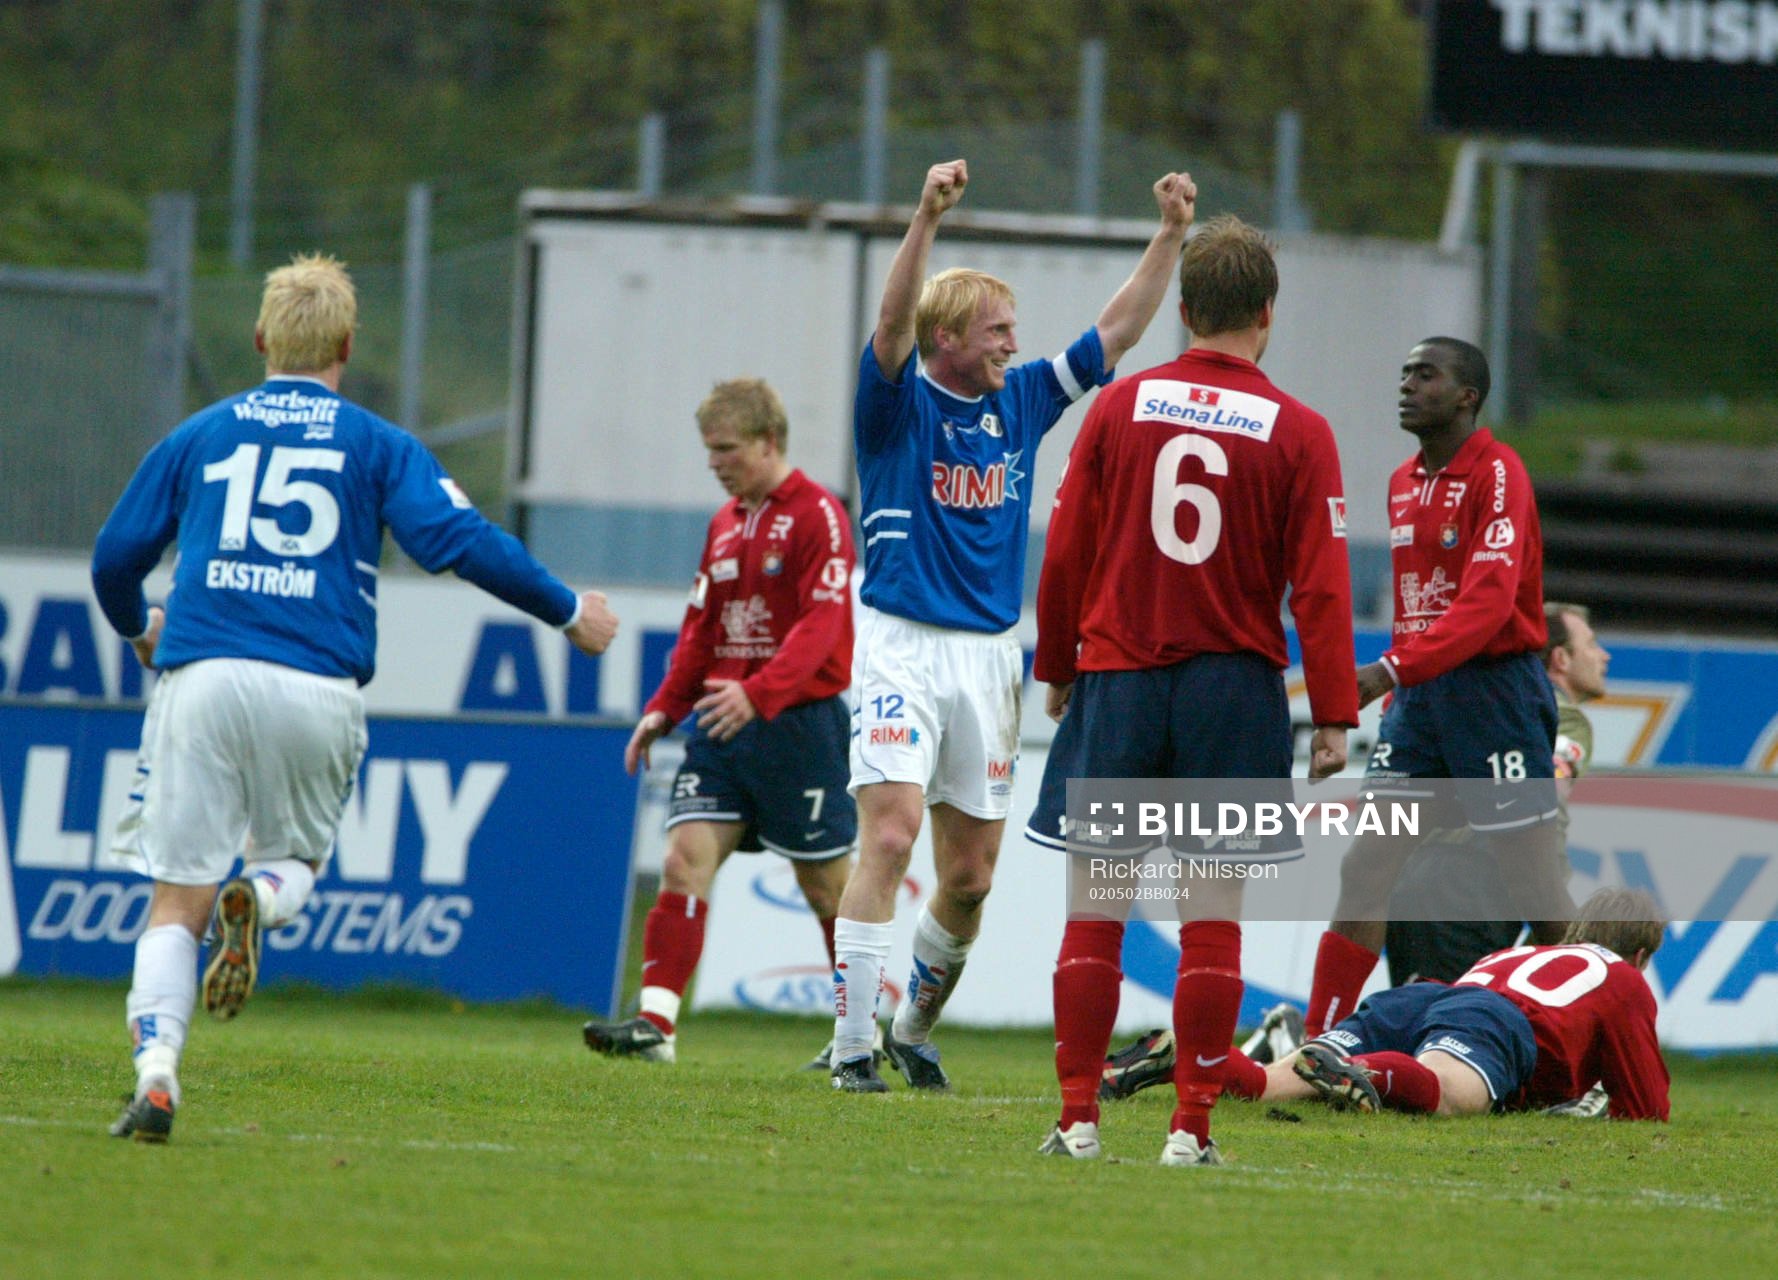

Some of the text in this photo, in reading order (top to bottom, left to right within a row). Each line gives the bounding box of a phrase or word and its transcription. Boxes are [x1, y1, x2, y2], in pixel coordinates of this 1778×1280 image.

[202, 442, 346, 557] 15
[931, 461, 1005, 508] RIMI
[1151, 432, 1230, 566] 6
[206, 558, 316, 599] EKSTRÖM
[870, 694, 905, 719] 12
[870, 727, 911, 746] RIMI
[1486, 750, 1528, 785] 18
[803, 788, 825, 822] 7
[1453, 945, 1608, 1007] 20
